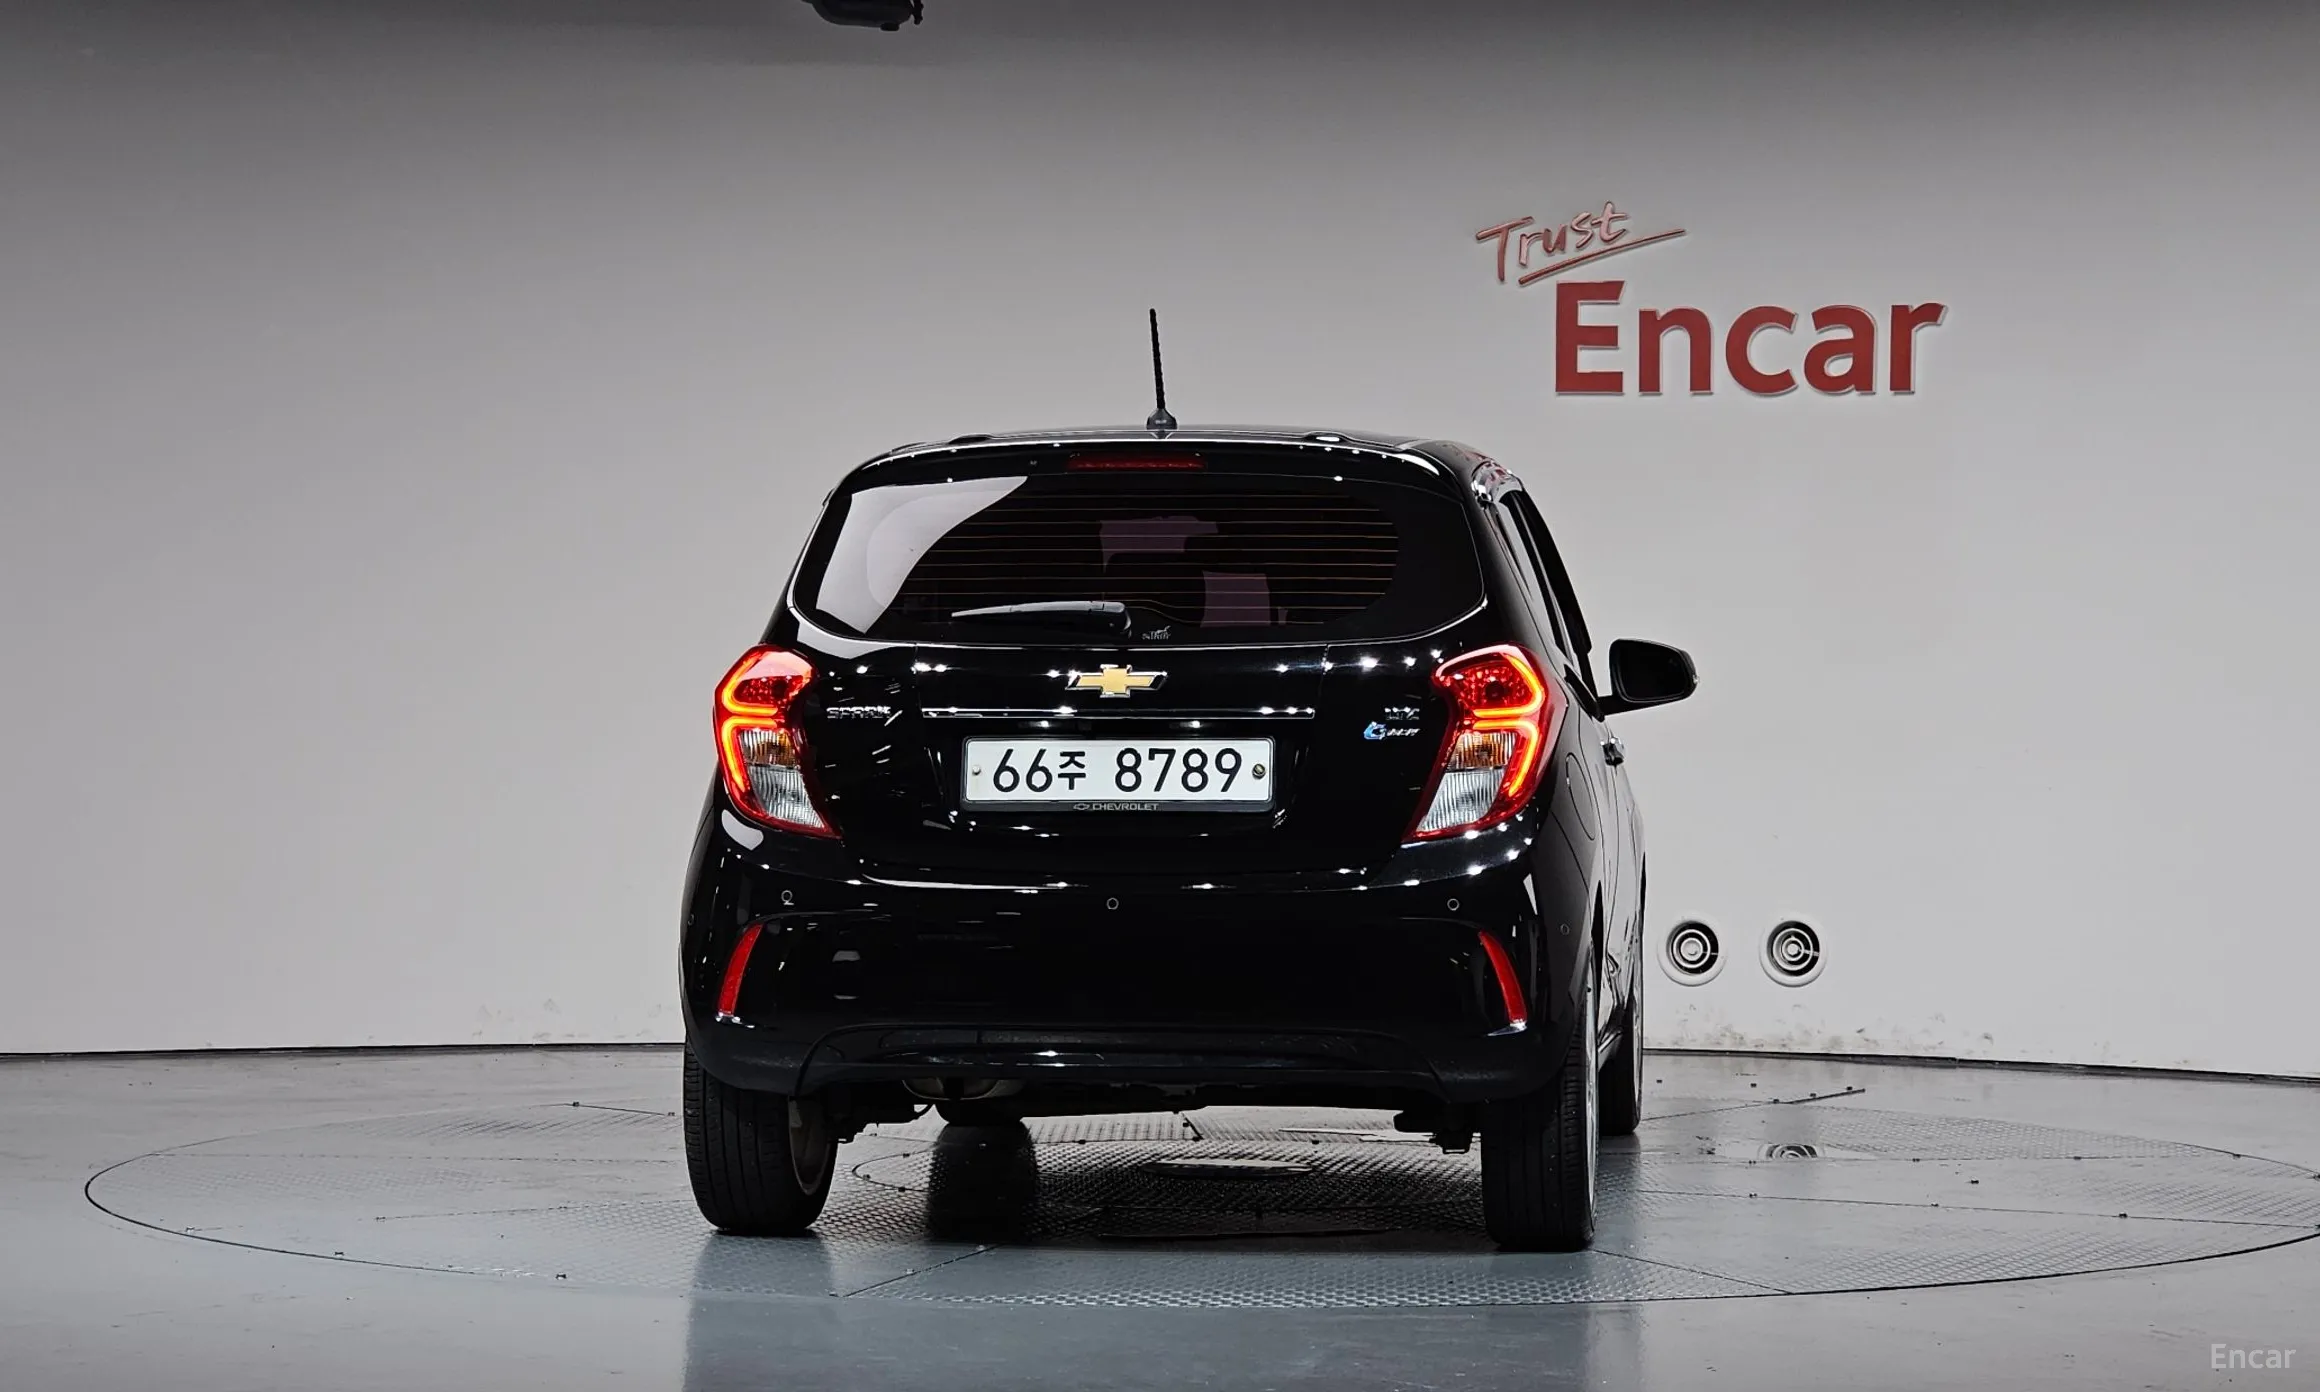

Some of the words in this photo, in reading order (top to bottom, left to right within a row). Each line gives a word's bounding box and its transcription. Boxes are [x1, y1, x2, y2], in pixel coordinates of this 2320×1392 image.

[1475, 200, 1627, 282] Trust
[1555, 280, 1947, 397] Encar
[992, 748, 1087, 793] 66주
[1114, 747, 1243, 793] 8789
[1092, 802, 1160, 811] CHEVROLET
